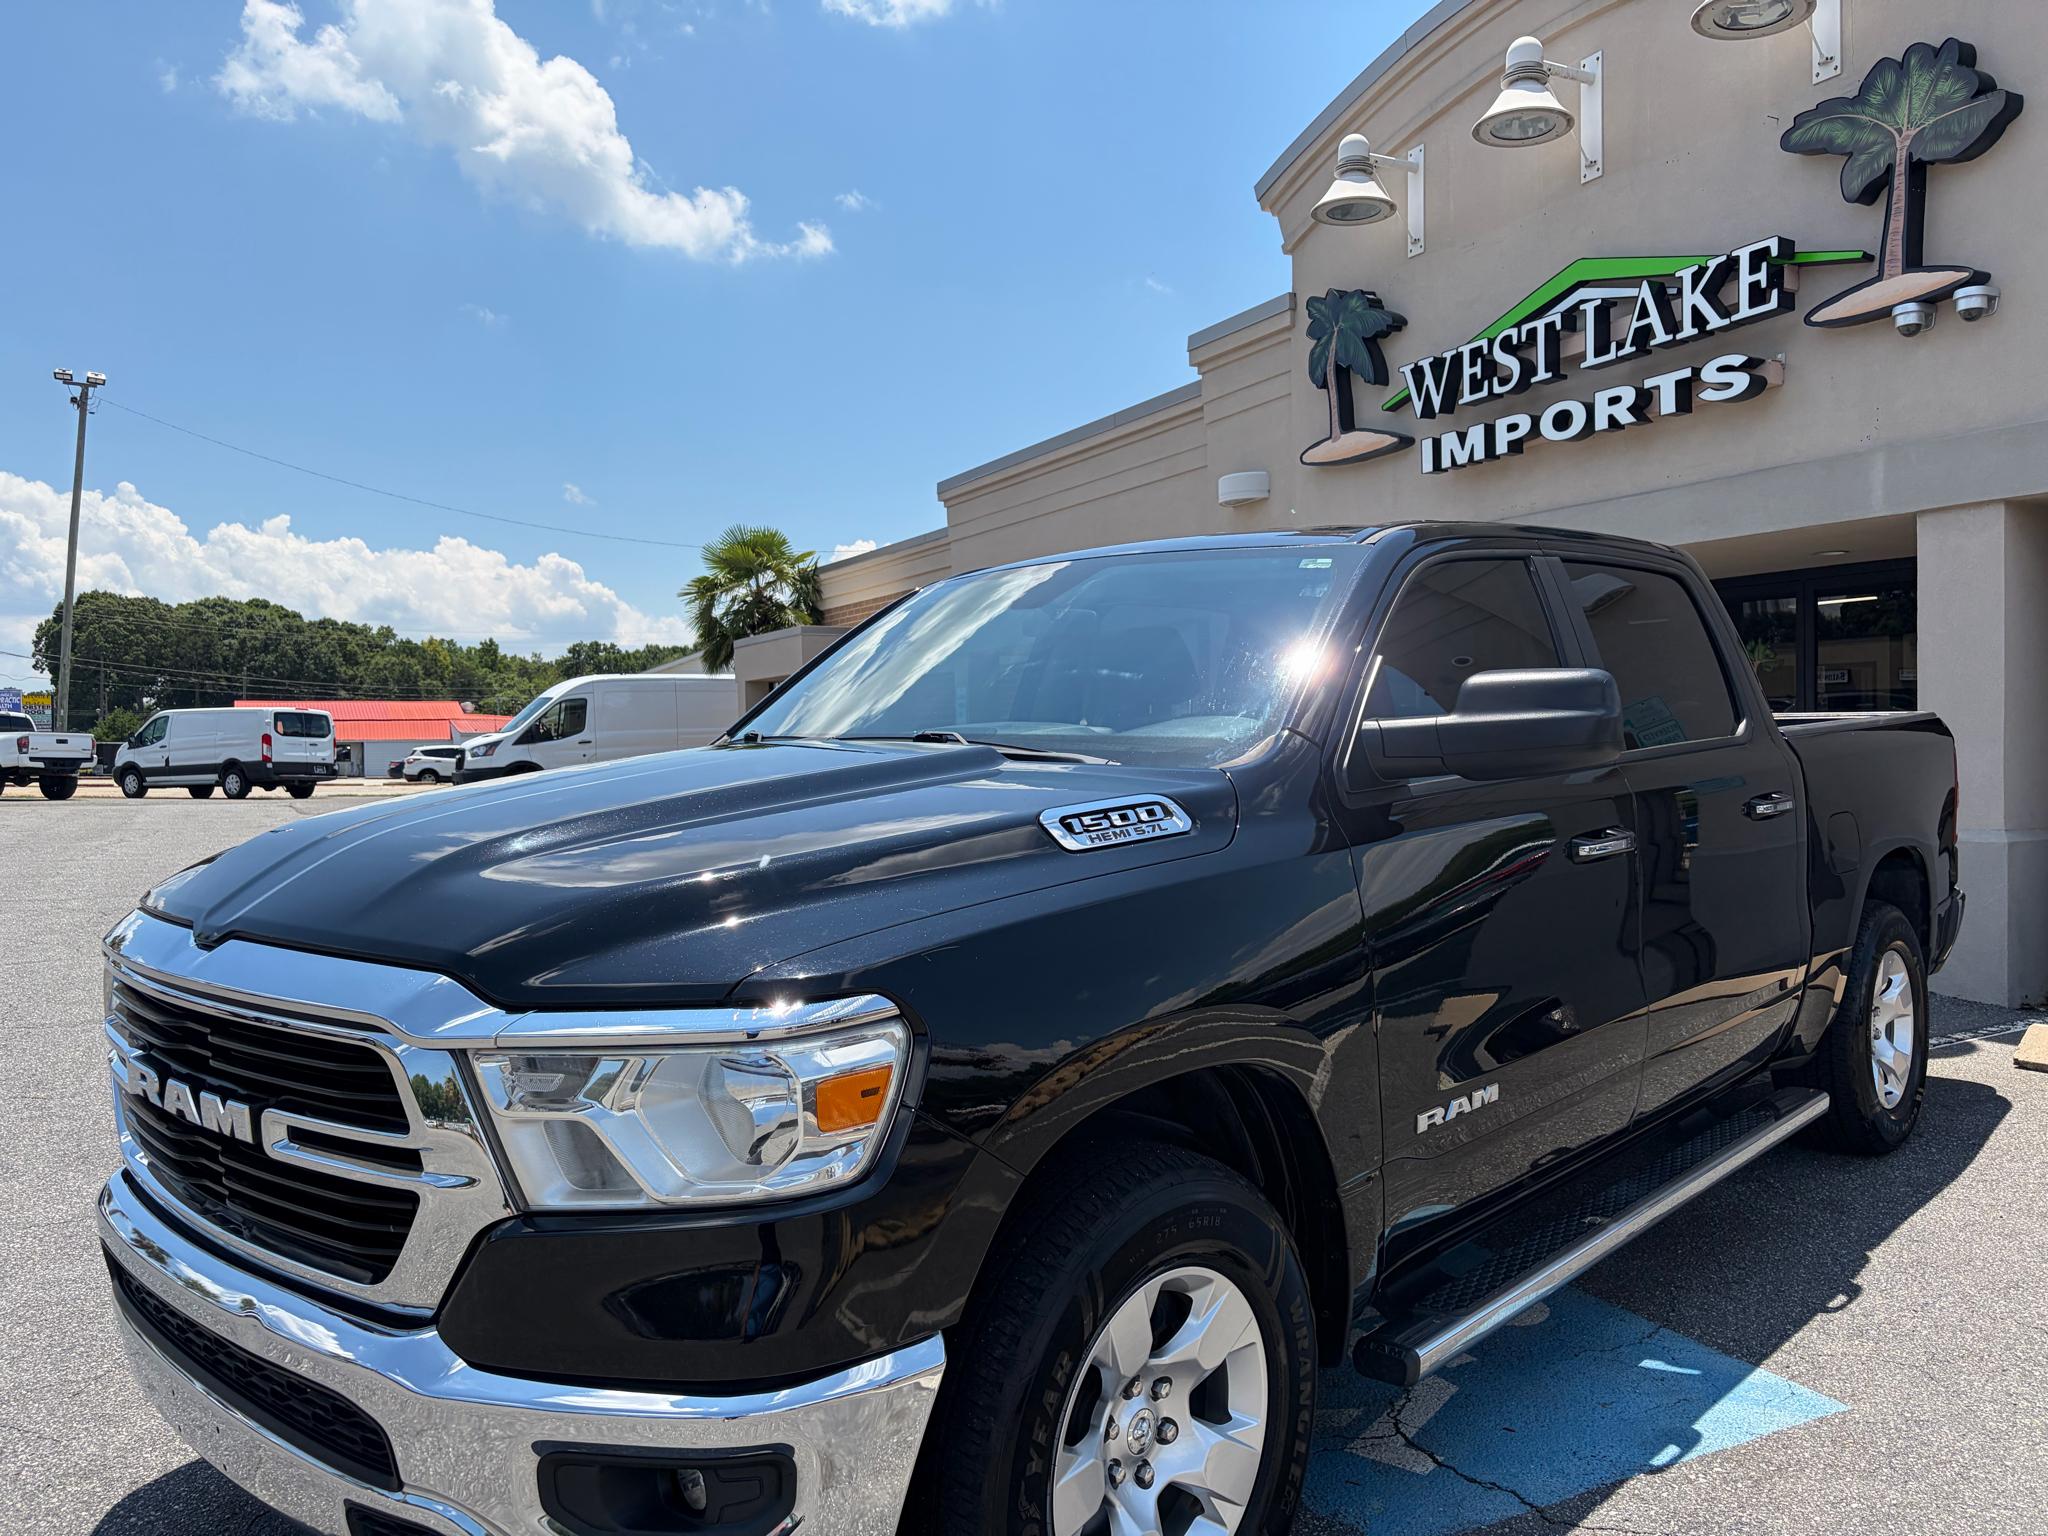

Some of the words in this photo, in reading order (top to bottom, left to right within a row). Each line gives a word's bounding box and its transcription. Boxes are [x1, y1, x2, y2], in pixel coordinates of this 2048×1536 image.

[1399, 311, 1563, 420] WEST
[1579, 235, 1783, 370] LAKE
[1421, 353, 1755, 475] IMPORTS
[1063, 804, 1166, 834] 1500
[1087, 827, 1132, 844] HEMI
[1135, 823, 1169, 836] 5.7L
[127, 1057, 254, 1145] RAM
[1417, 1082, 1499, 1134] RAM
[1280, 1295, 1314, 1514] WRANGLER
